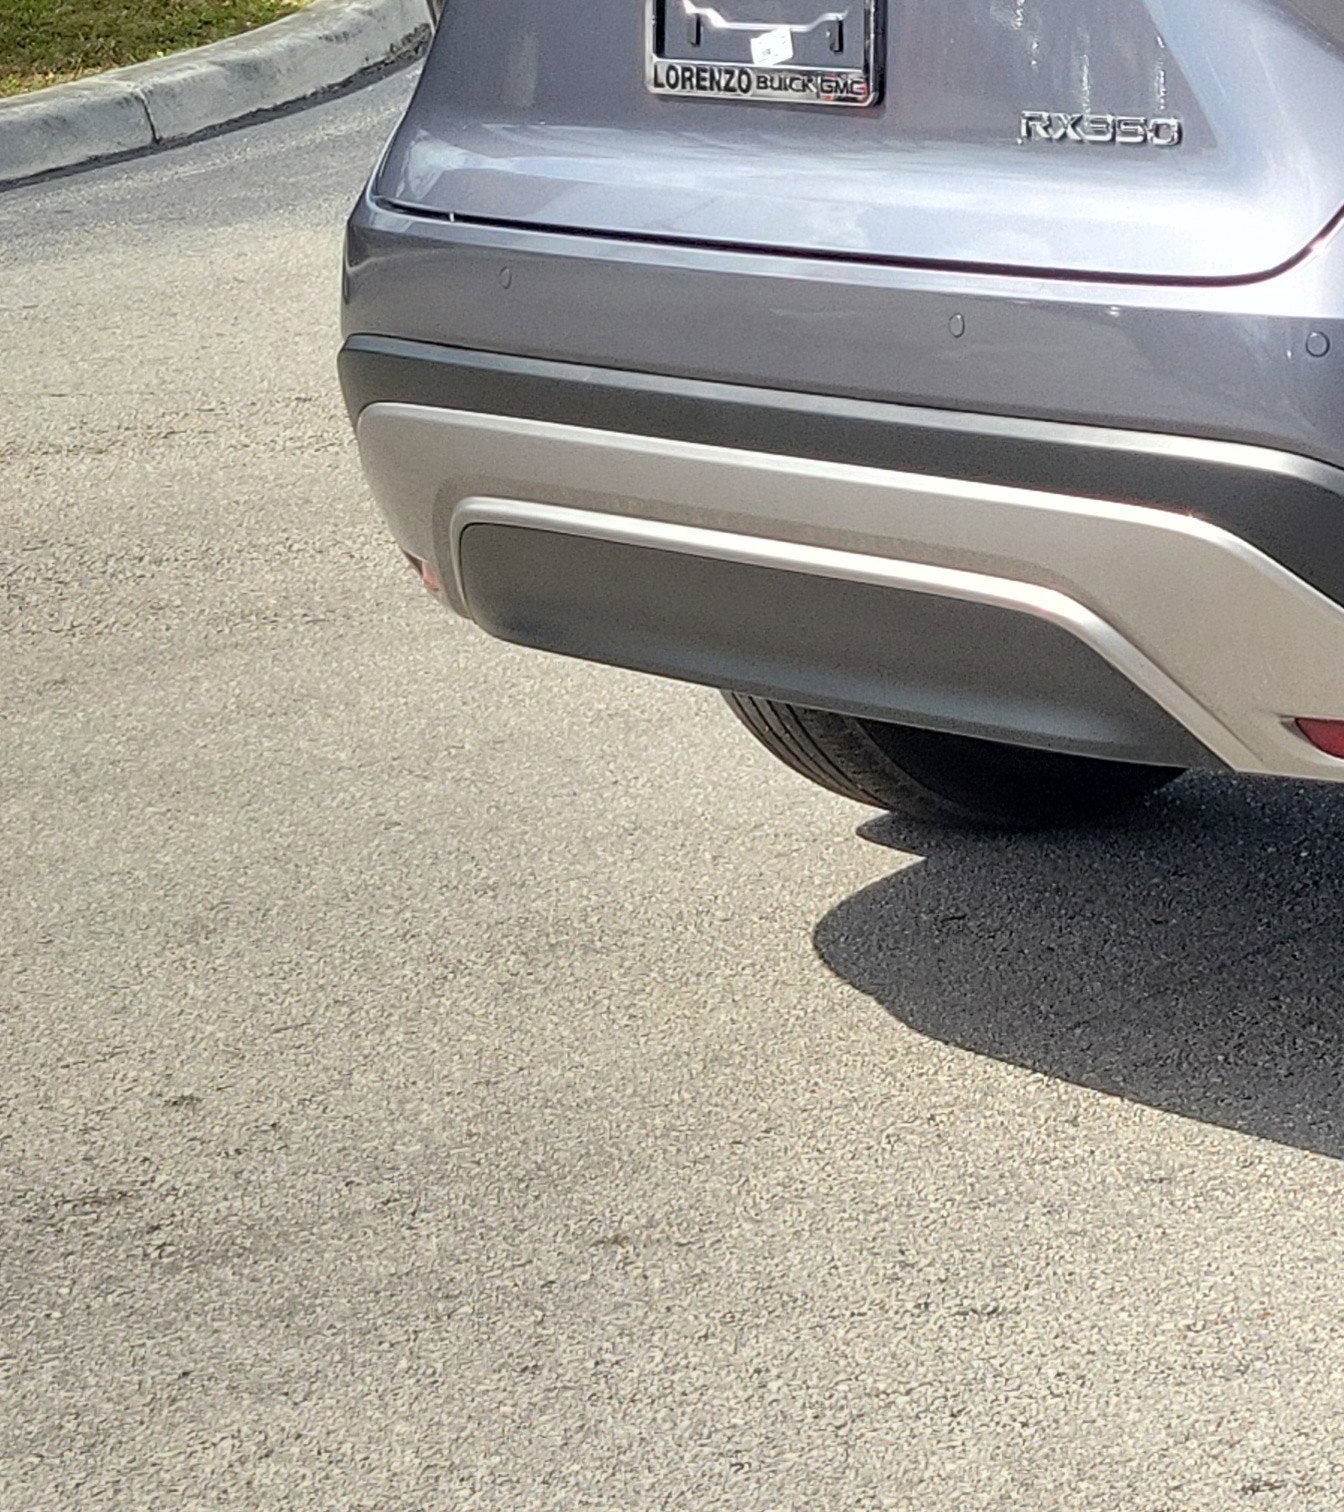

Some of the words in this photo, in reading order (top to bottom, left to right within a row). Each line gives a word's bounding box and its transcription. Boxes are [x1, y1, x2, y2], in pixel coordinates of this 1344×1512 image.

[653, 65, 752, 94] LORENZO
[756, 74, 818, 94] BUICK
[820, 76, 867, 96] GMC
[1020, 110, 1183, 146] RX350
